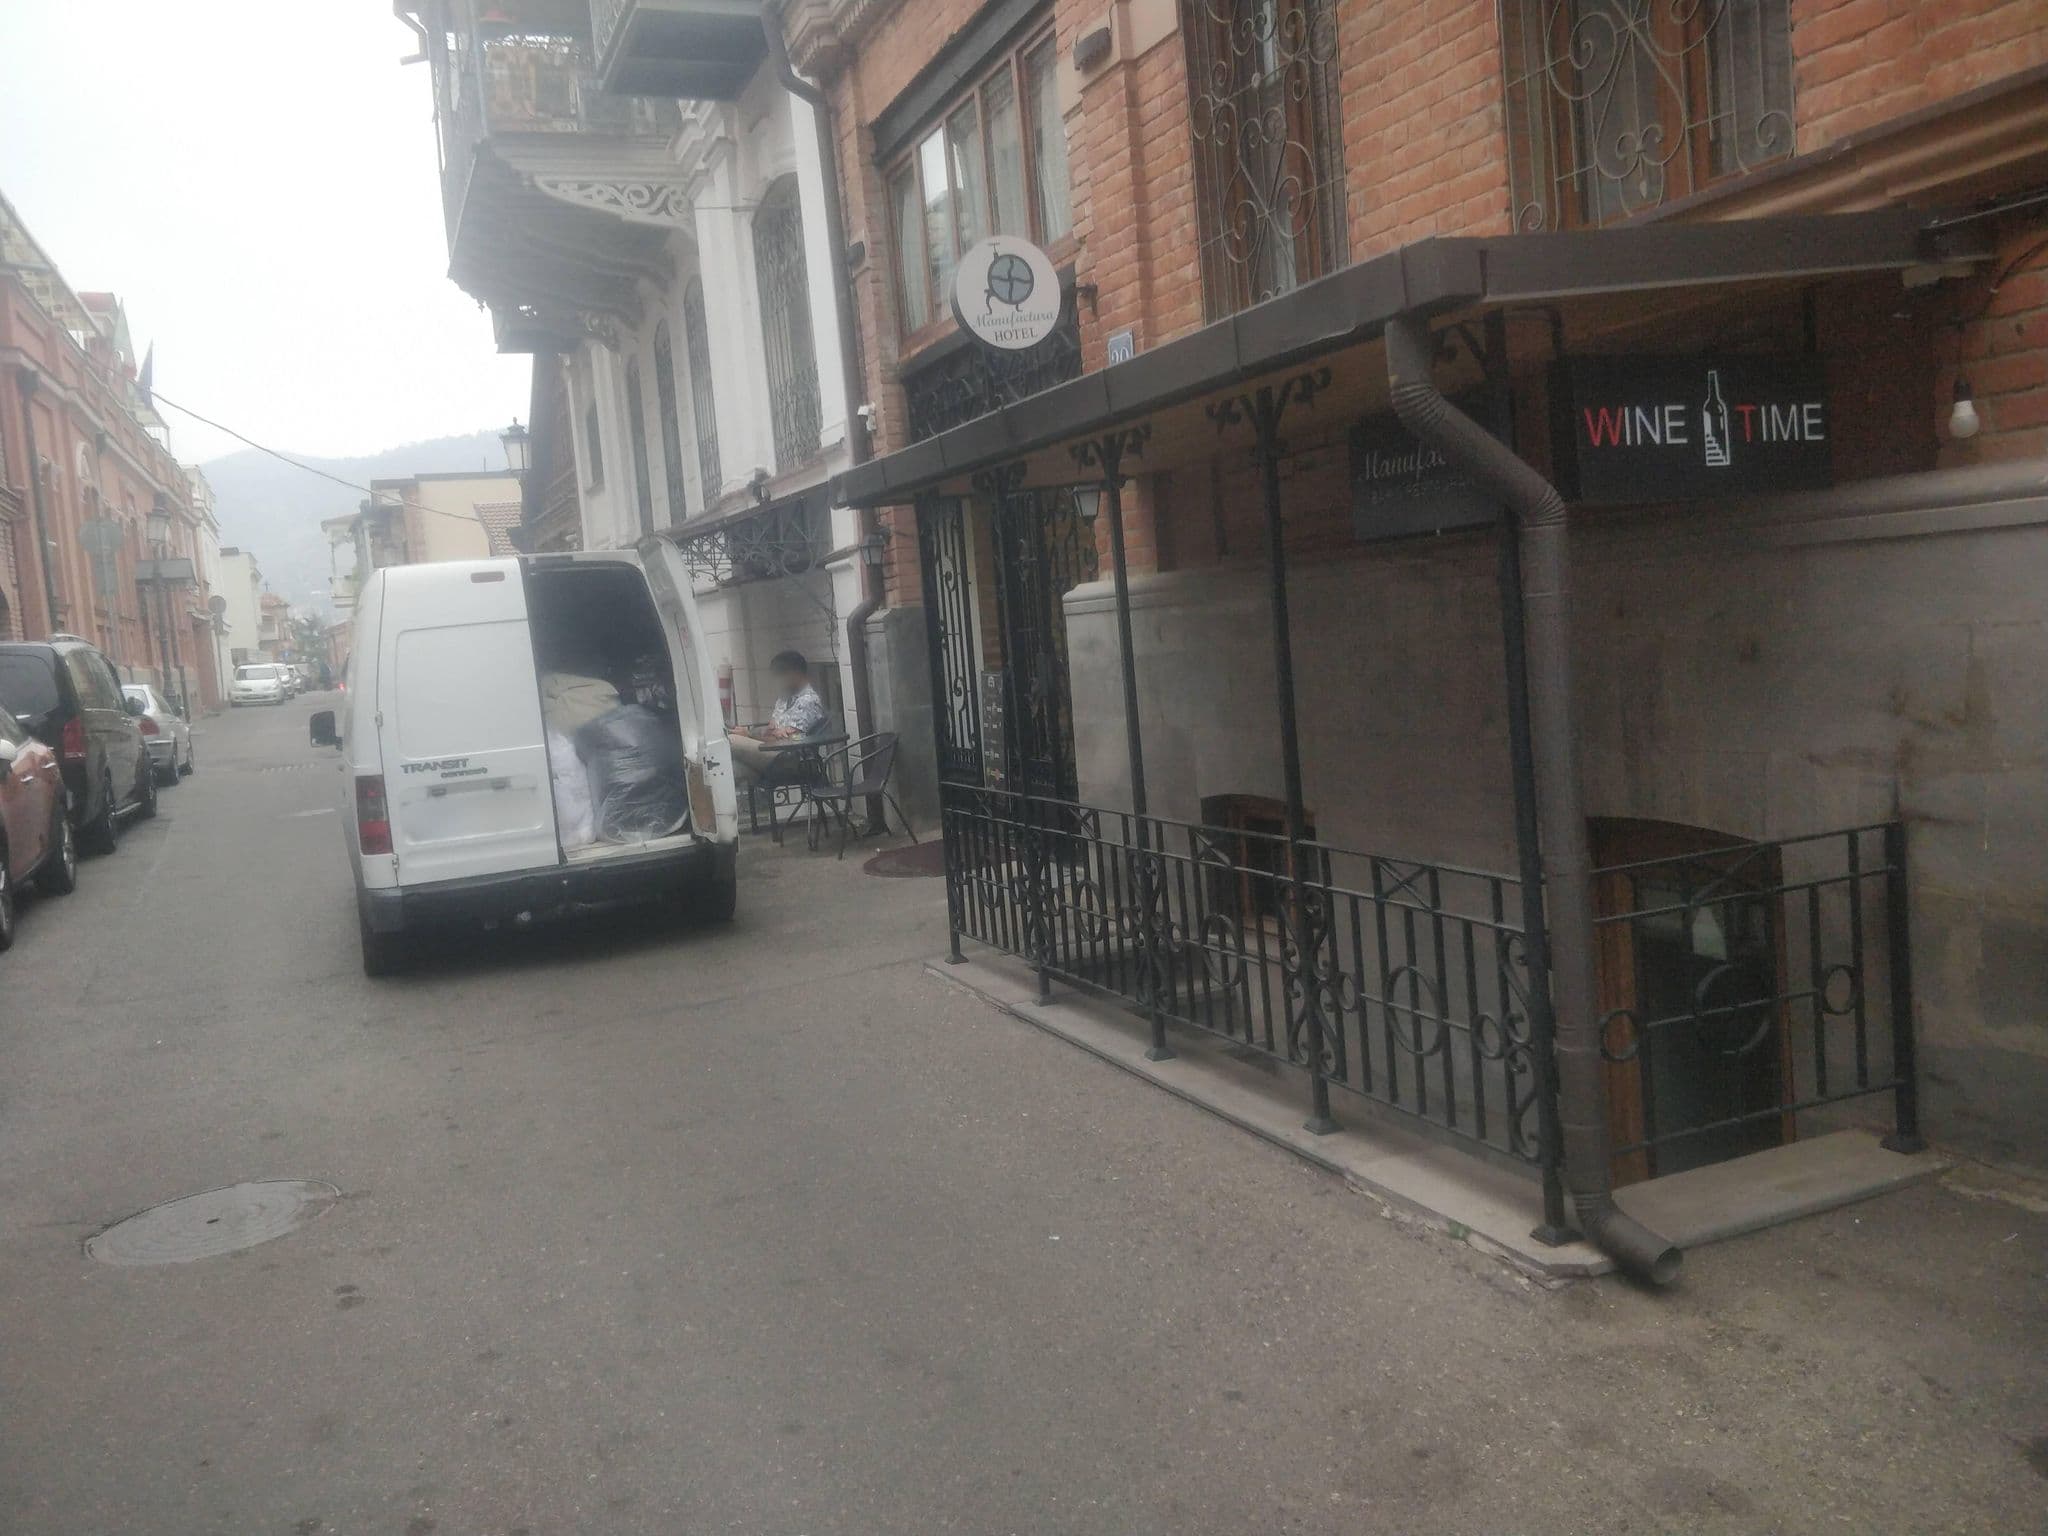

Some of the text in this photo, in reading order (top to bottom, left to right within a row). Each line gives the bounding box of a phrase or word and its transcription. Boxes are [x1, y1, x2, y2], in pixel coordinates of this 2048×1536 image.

[995, 327, 1039, 343] HOTEL
[1584, 403, 1825, 447] WINE TIME
[400, 758, 470, 774] TRANSIT
